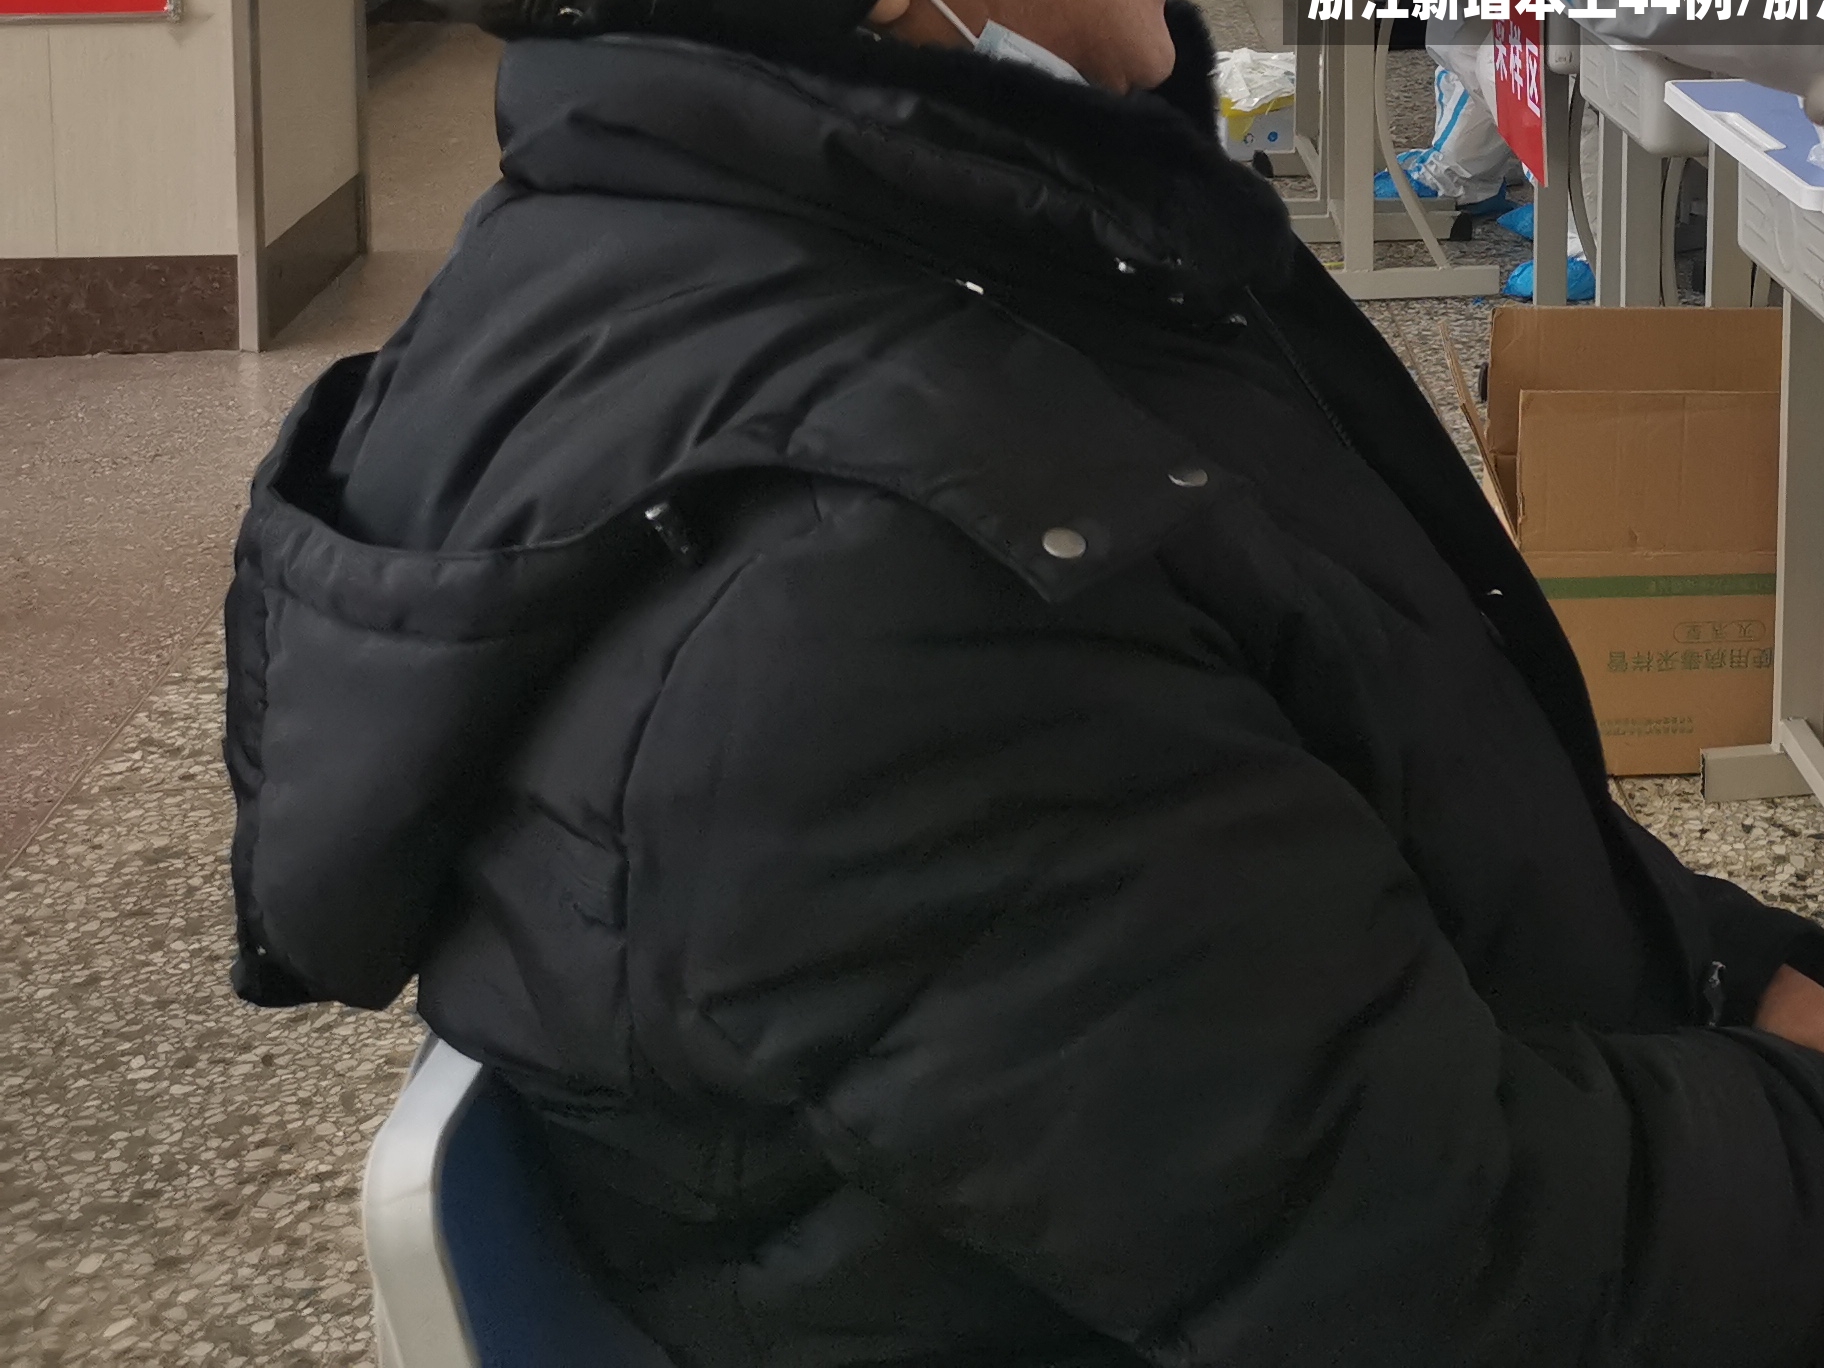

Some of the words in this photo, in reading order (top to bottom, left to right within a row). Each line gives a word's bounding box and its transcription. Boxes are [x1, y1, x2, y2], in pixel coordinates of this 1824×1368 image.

[1608, 647, 1775, 673] 使用病毒采样管
